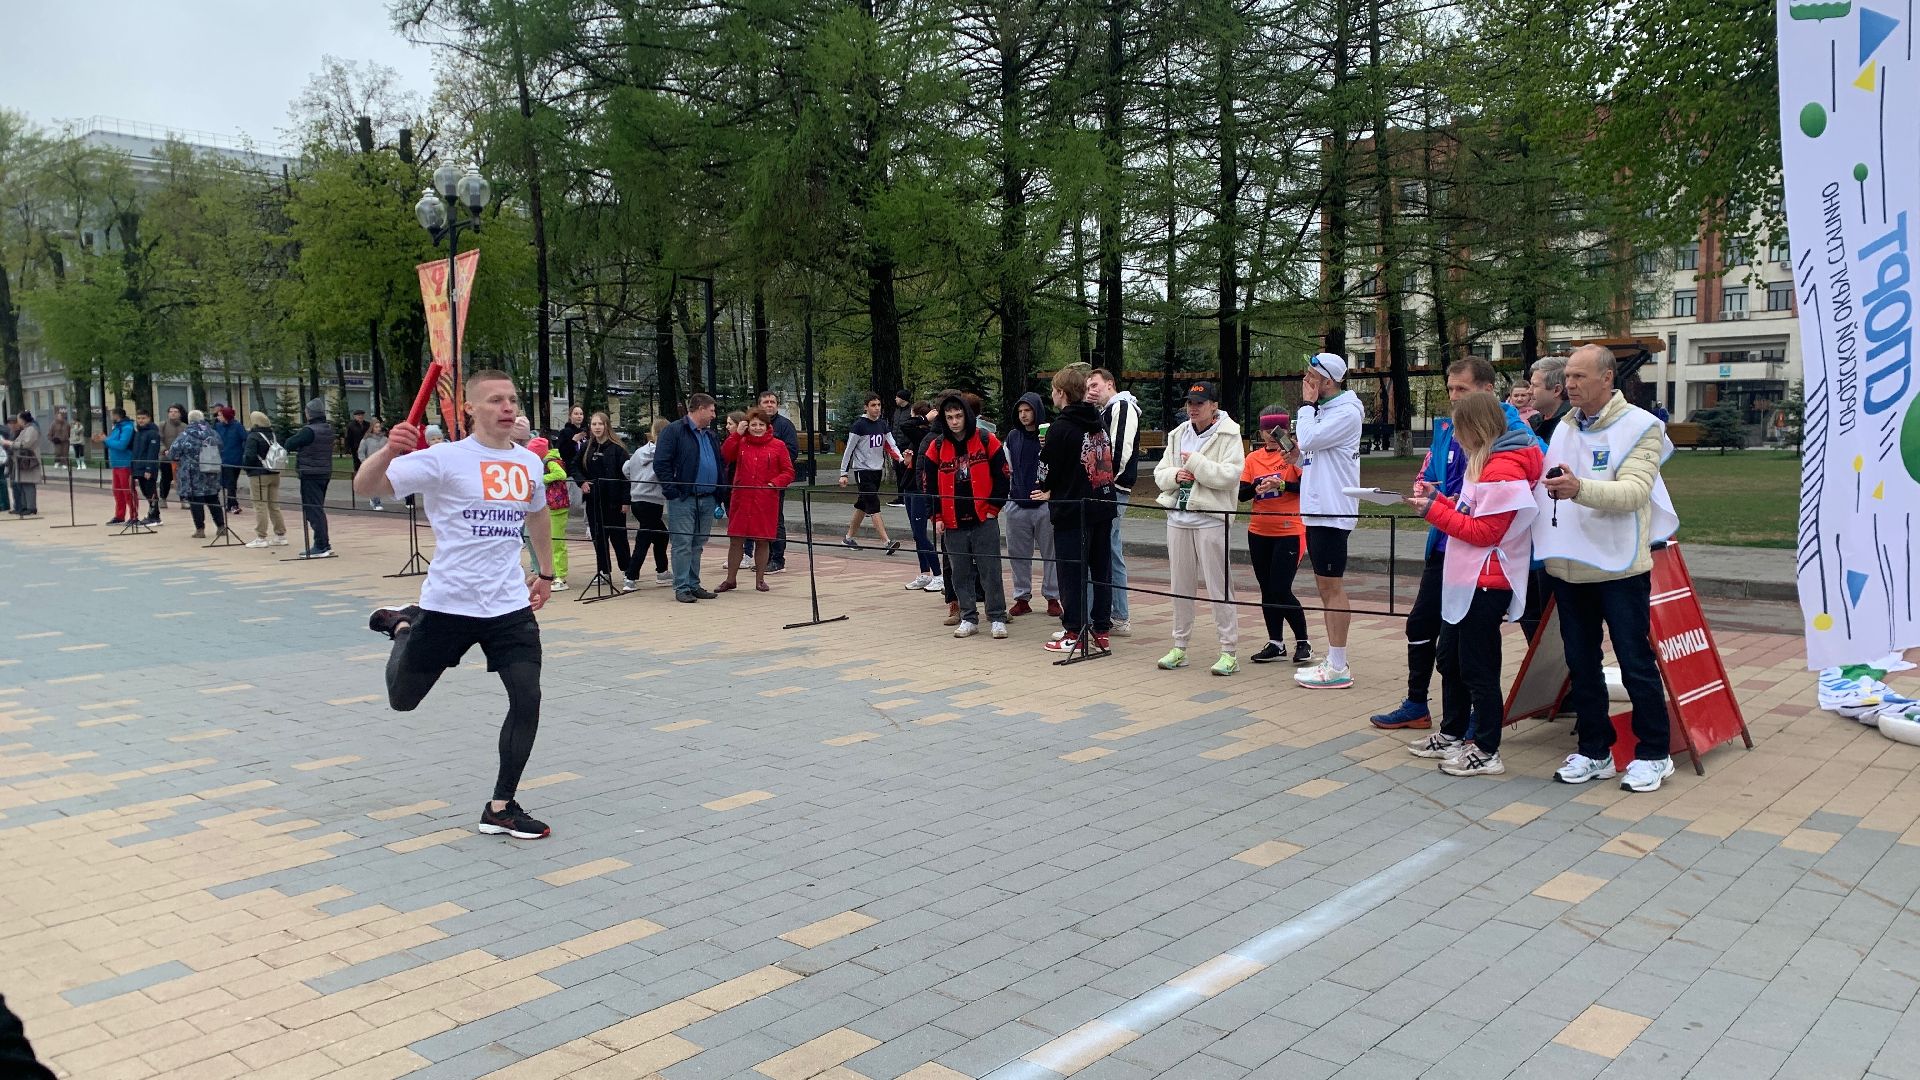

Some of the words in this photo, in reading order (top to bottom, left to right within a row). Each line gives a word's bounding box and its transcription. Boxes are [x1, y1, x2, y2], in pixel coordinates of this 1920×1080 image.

[432, 267, 444, 296] 9
[870, 434, 882, 447] 10
[486, 464, 529, 500] 30
[1658, 627, 1709, 663] ФИНИШ
